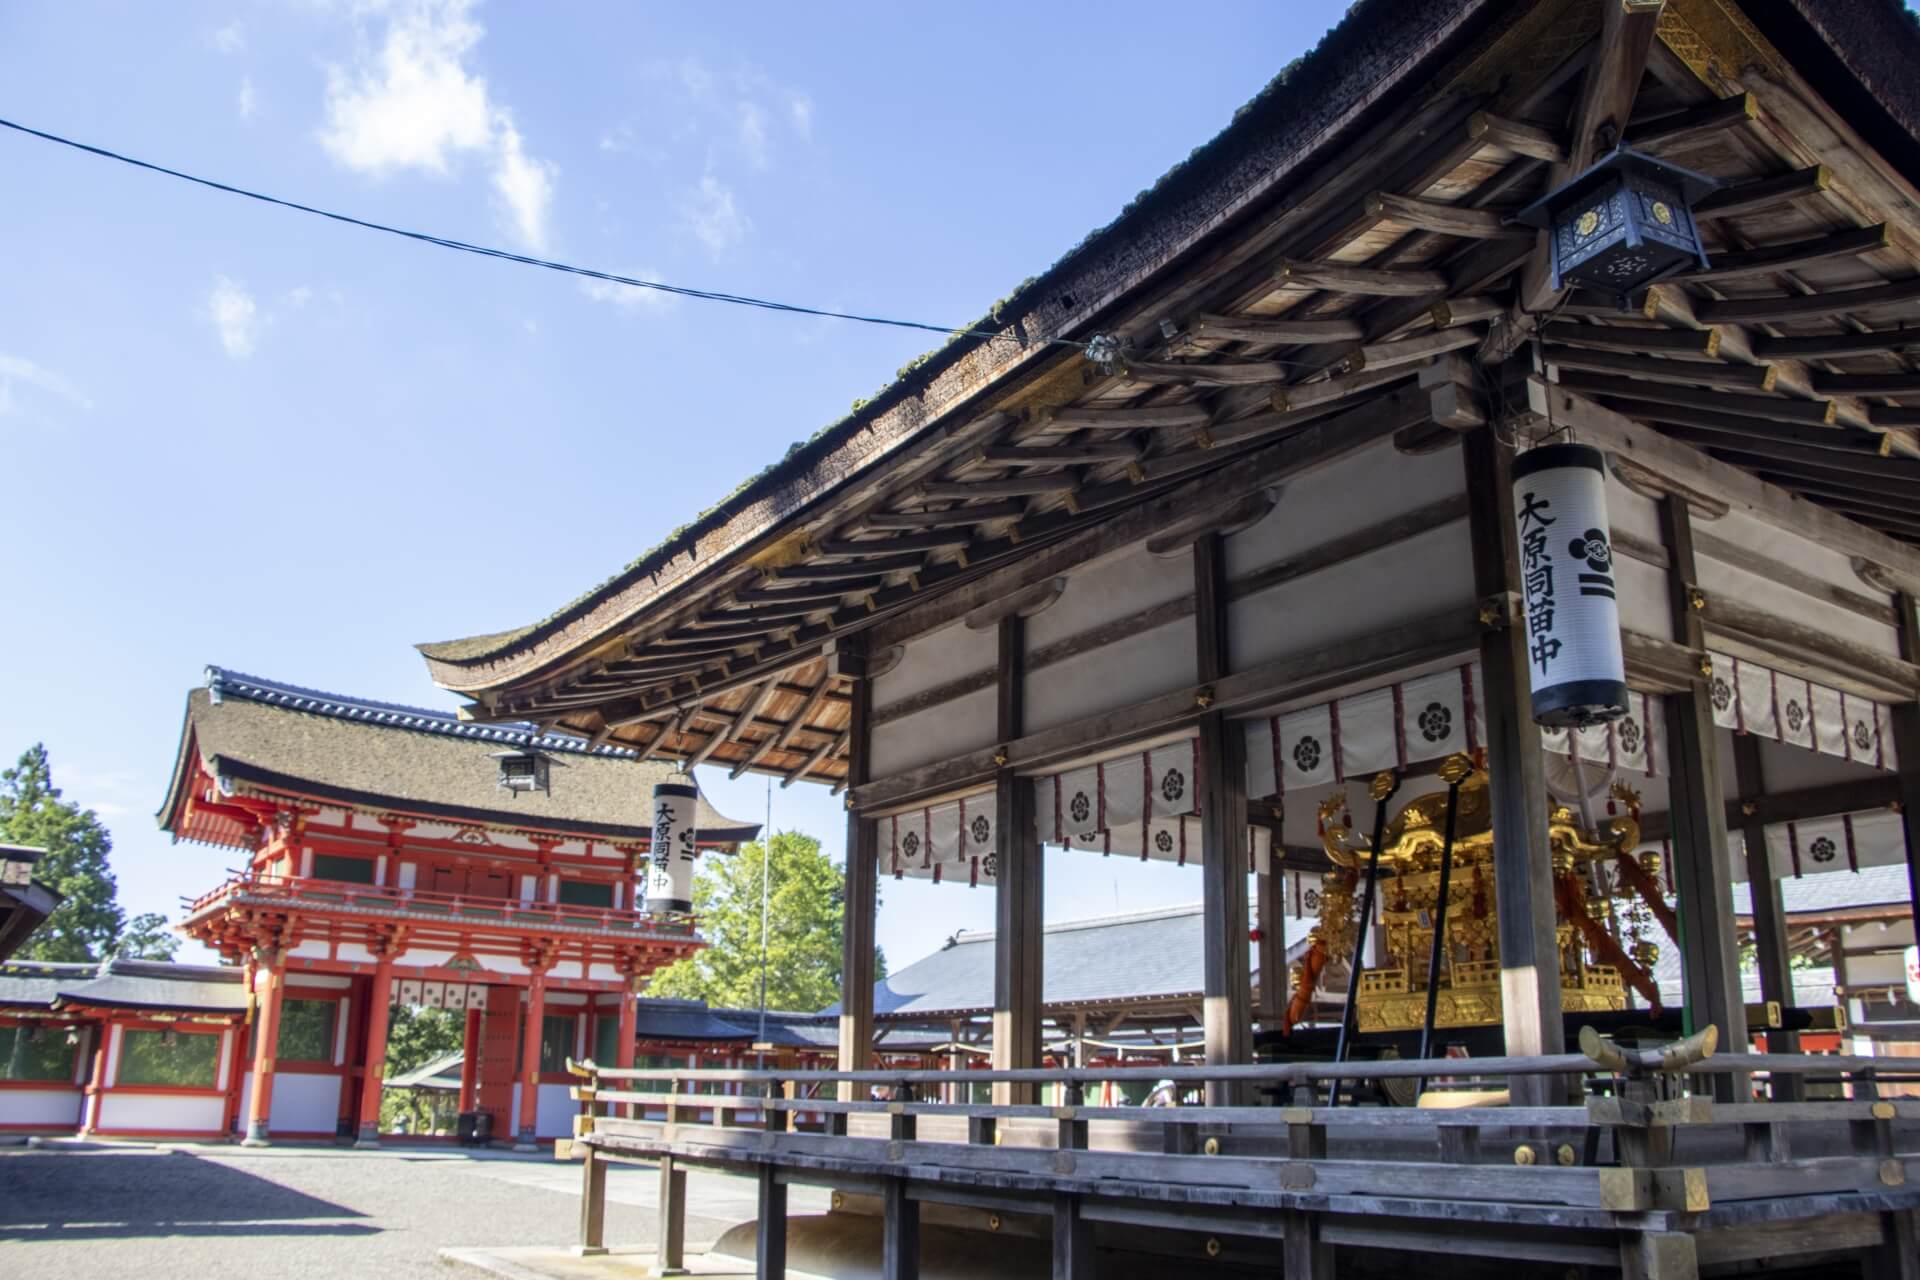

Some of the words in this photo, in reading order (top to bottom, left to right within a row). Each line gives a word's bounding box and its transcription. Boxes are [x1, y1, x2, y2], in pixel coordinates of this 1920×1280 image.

[1518, 492, 1562, 676] 大原同苗中
